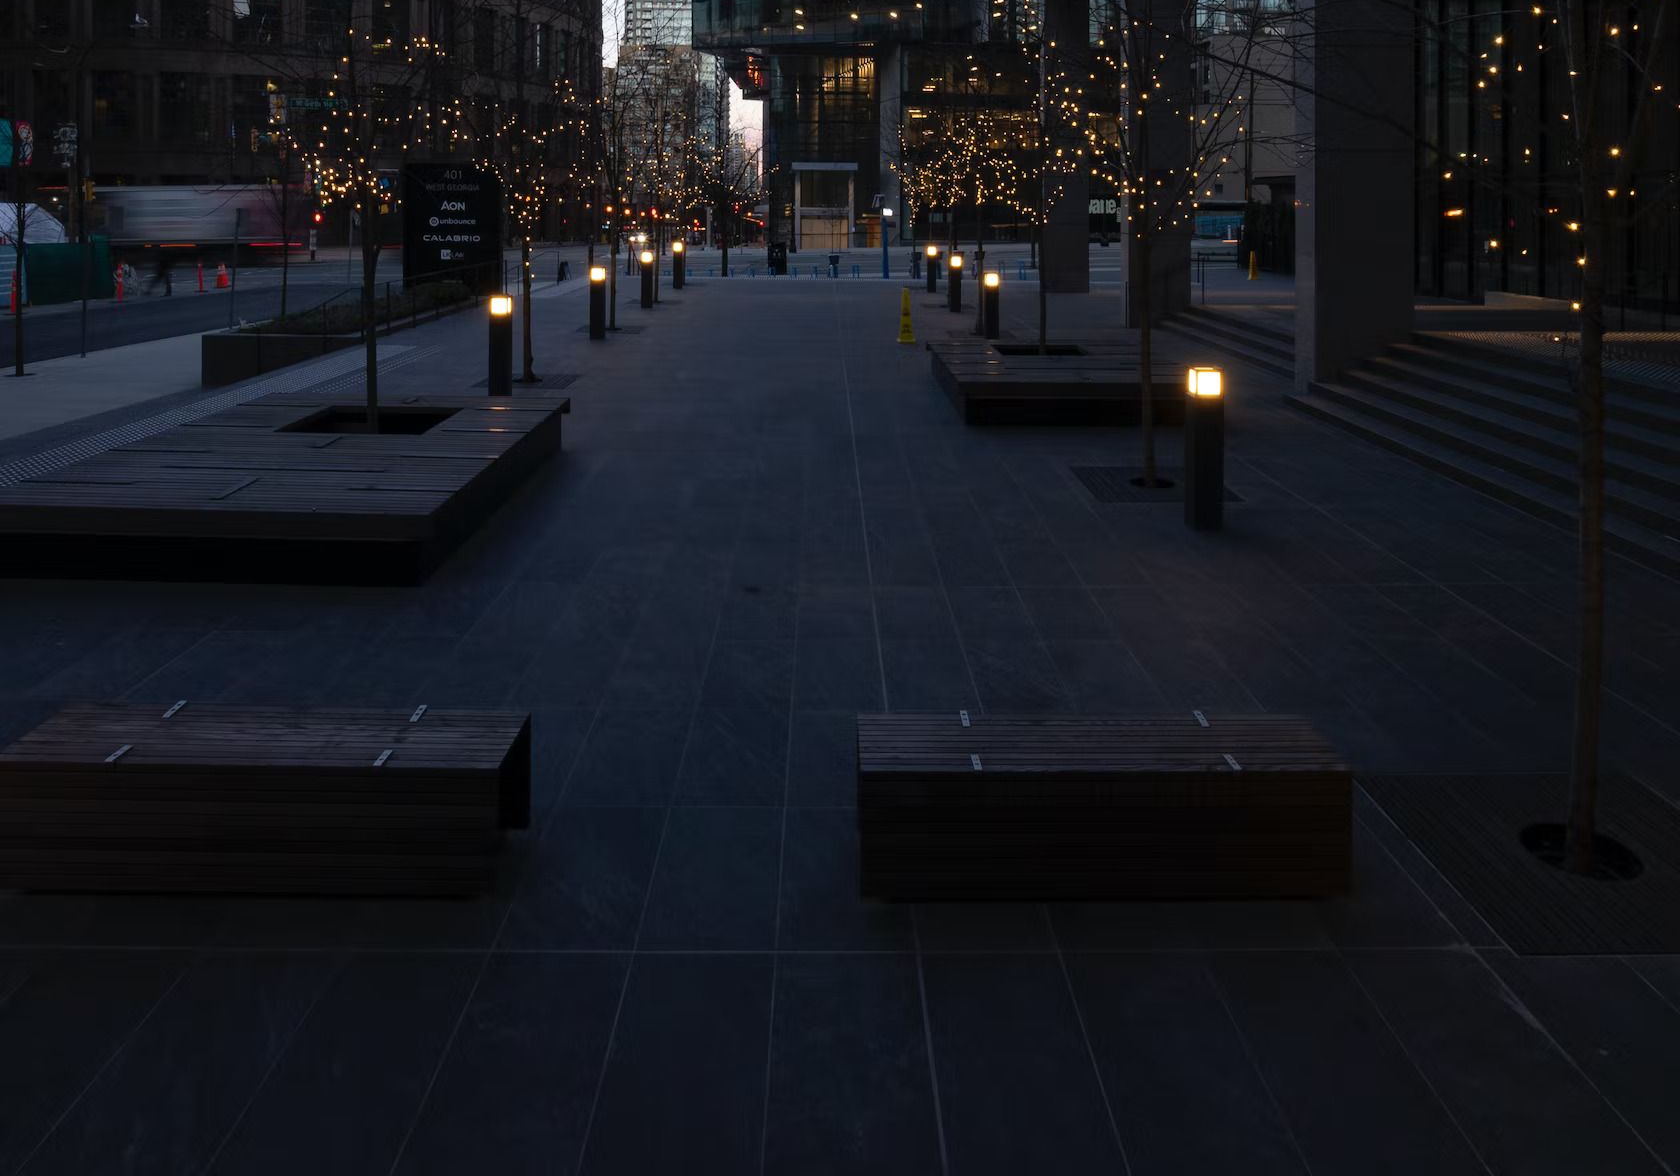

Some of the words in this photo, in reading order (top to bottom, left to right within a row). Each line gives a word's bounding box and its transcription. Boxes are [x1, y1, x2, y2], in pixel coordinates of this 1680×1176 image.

[444, 170, 463, 180] 401
[425, 184, 446, 192] WEST
[447, 184, 480, 192] GEORGIA
[440, 217, 476, 225] unbounce
[423, 234, 481, 242] CALABRIO
